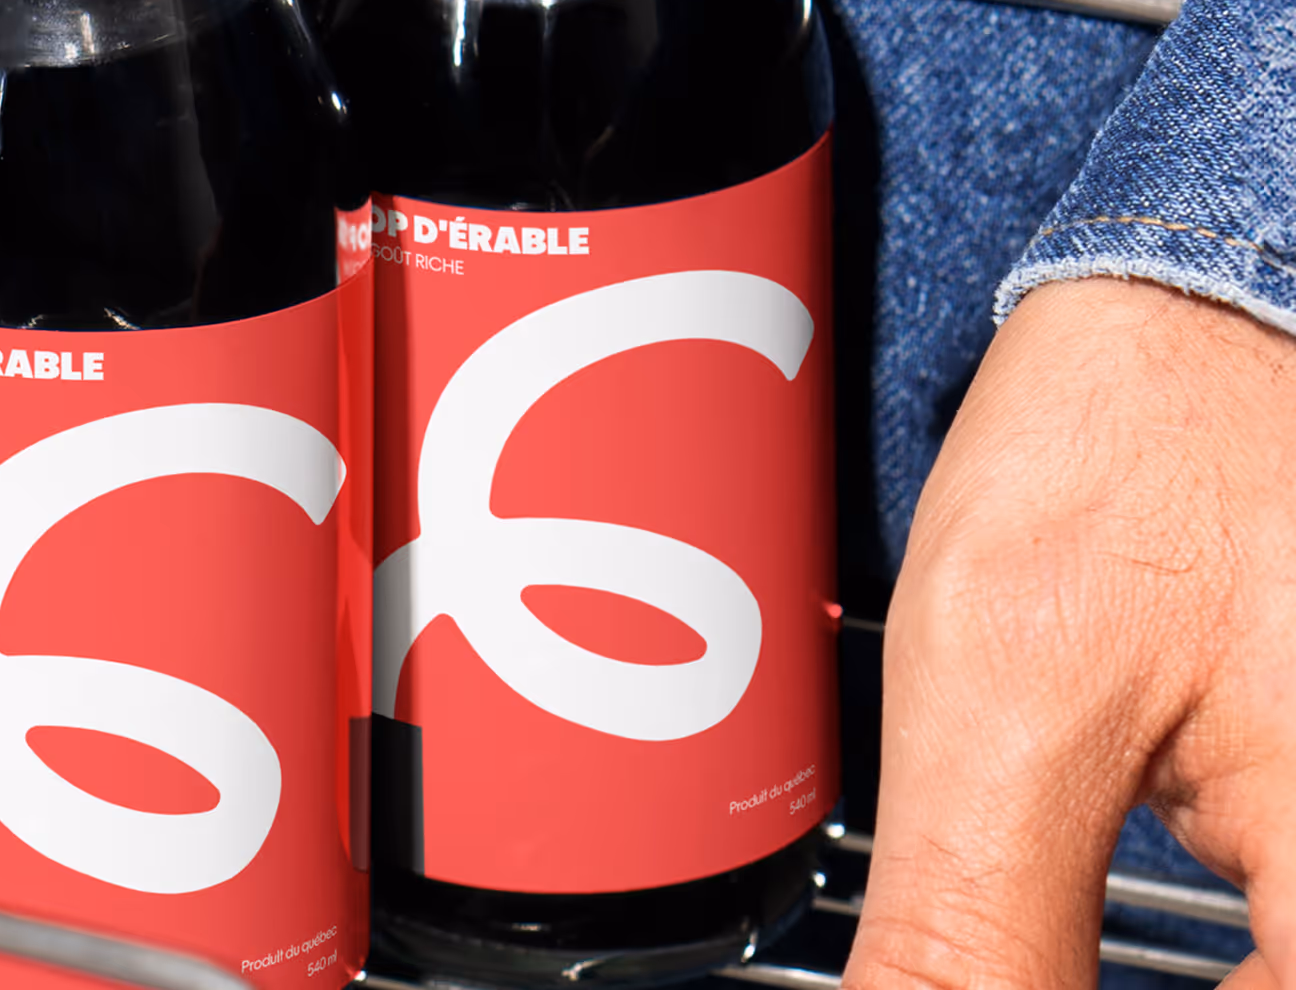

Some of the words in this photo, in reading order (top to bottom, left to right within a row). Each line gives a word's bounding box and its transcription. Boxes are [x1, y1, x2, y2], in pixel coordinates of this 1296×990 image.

[414, 215, 589, 255] D'ÉRABLE
[416, 254, 464, 275] RICHE
[729, 788, 768, 815] Produit
[769, 784, 782, 800] du
[789, 794, 806, 815] 540
[241, 949, 284, 973] Produit
[285, 944, 300, 959] du
[307, 956, 326, 977] 540
[327, 948, 338, 967] ml
